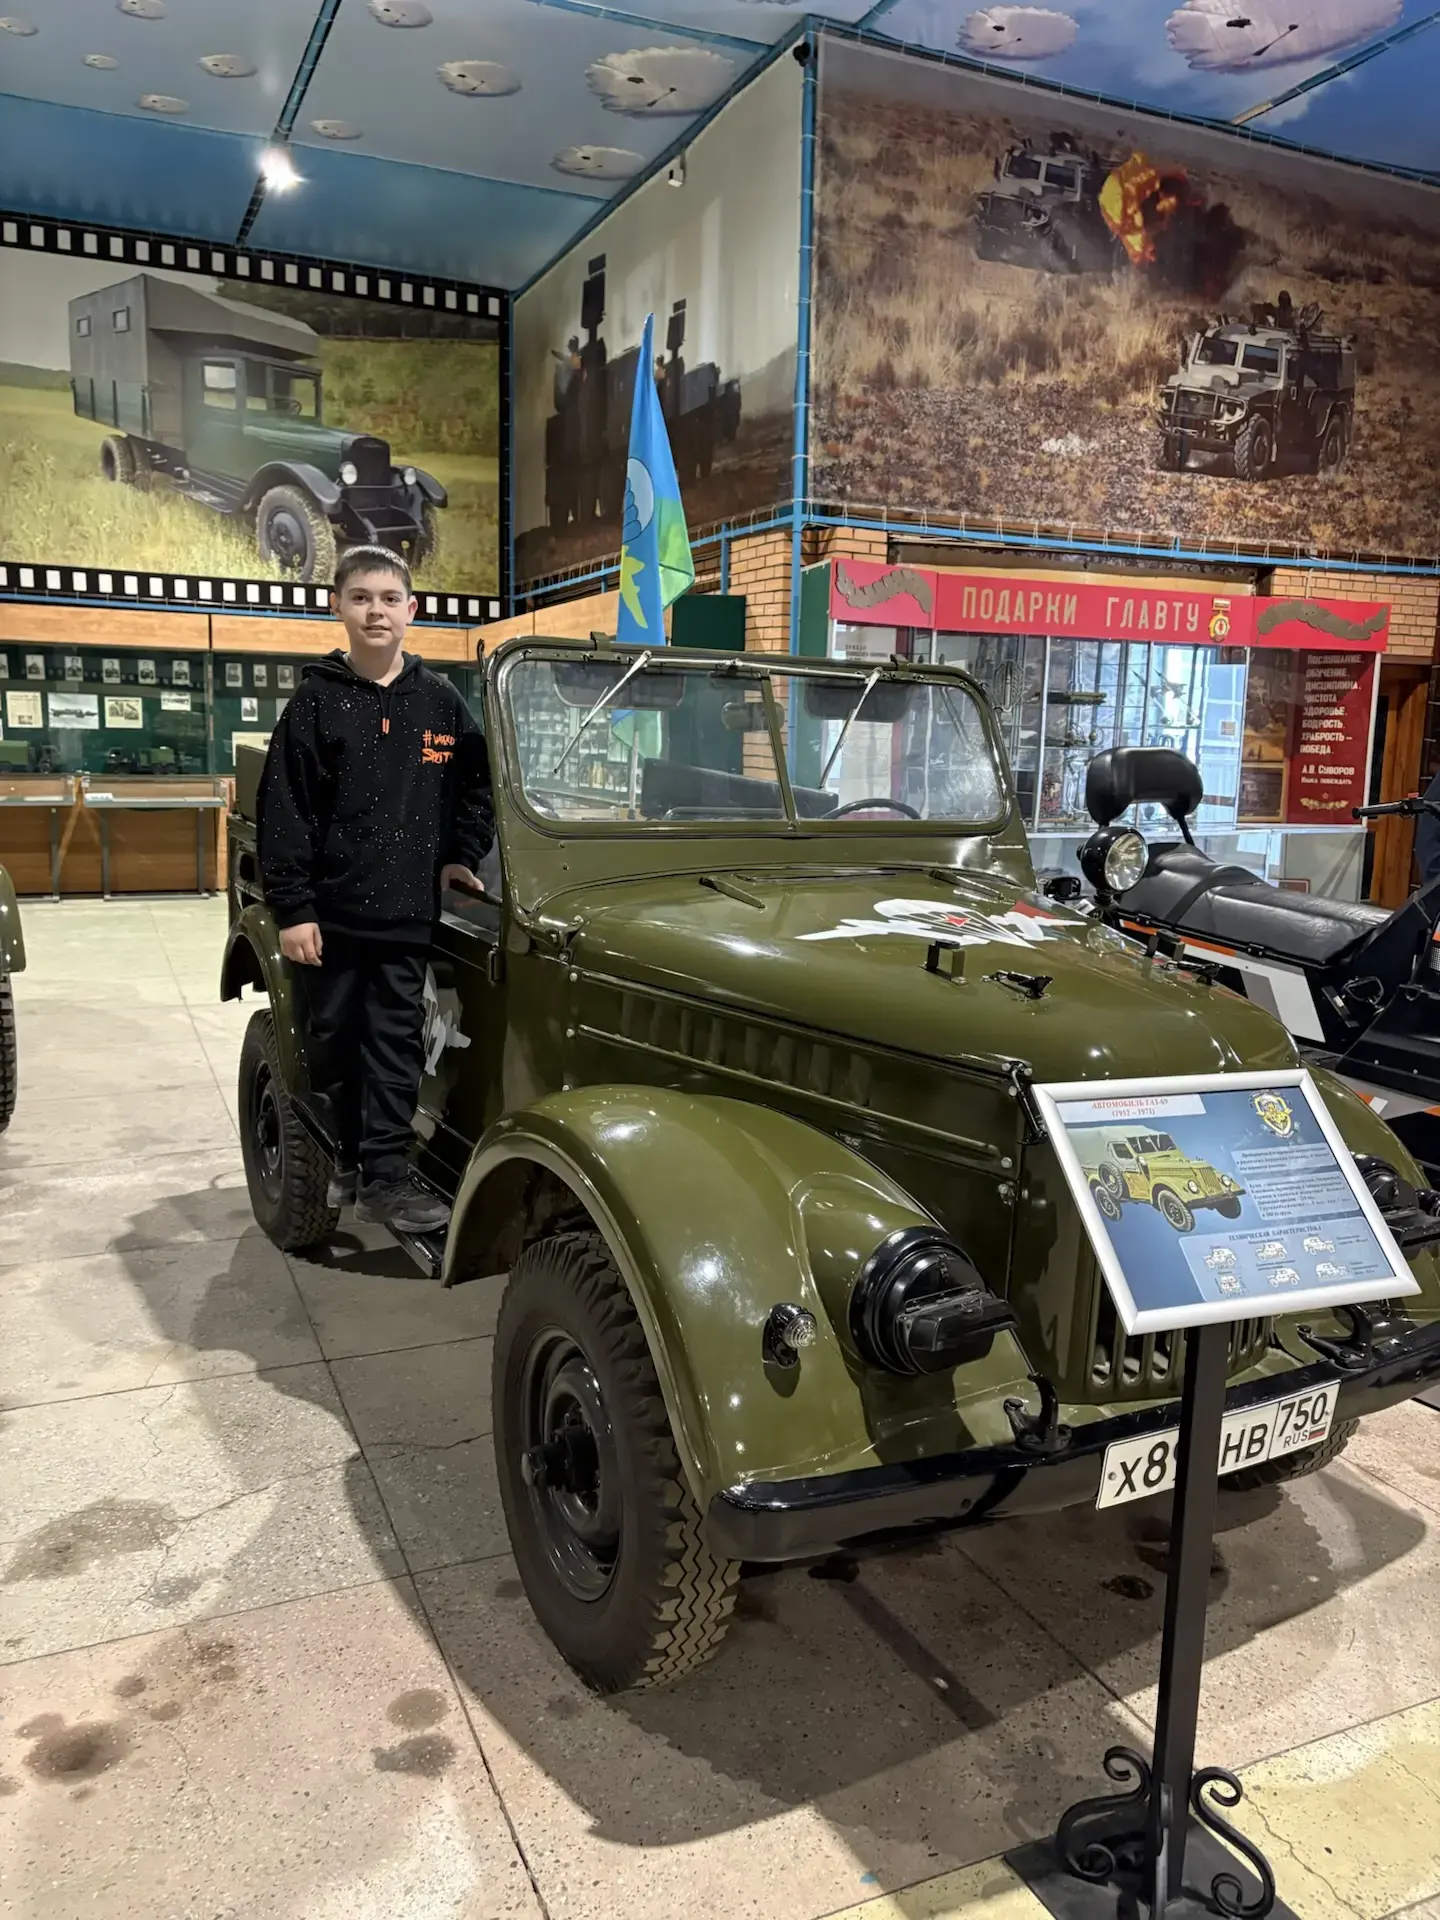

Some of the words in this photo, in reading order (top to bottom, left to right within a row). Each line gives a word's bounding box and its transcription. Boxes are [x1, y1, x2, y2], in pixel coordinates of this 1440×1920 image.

[962, 586, 1078, 625] ПОДАРКИ
[1105, 596, 1200, 632] ГЛАВТУ
[1317, 765, 1355, 775] СУВОРОВ
[1278, 1392, 1328, 1438] 750
[1283, 1430, 1308, 1449] RUS
